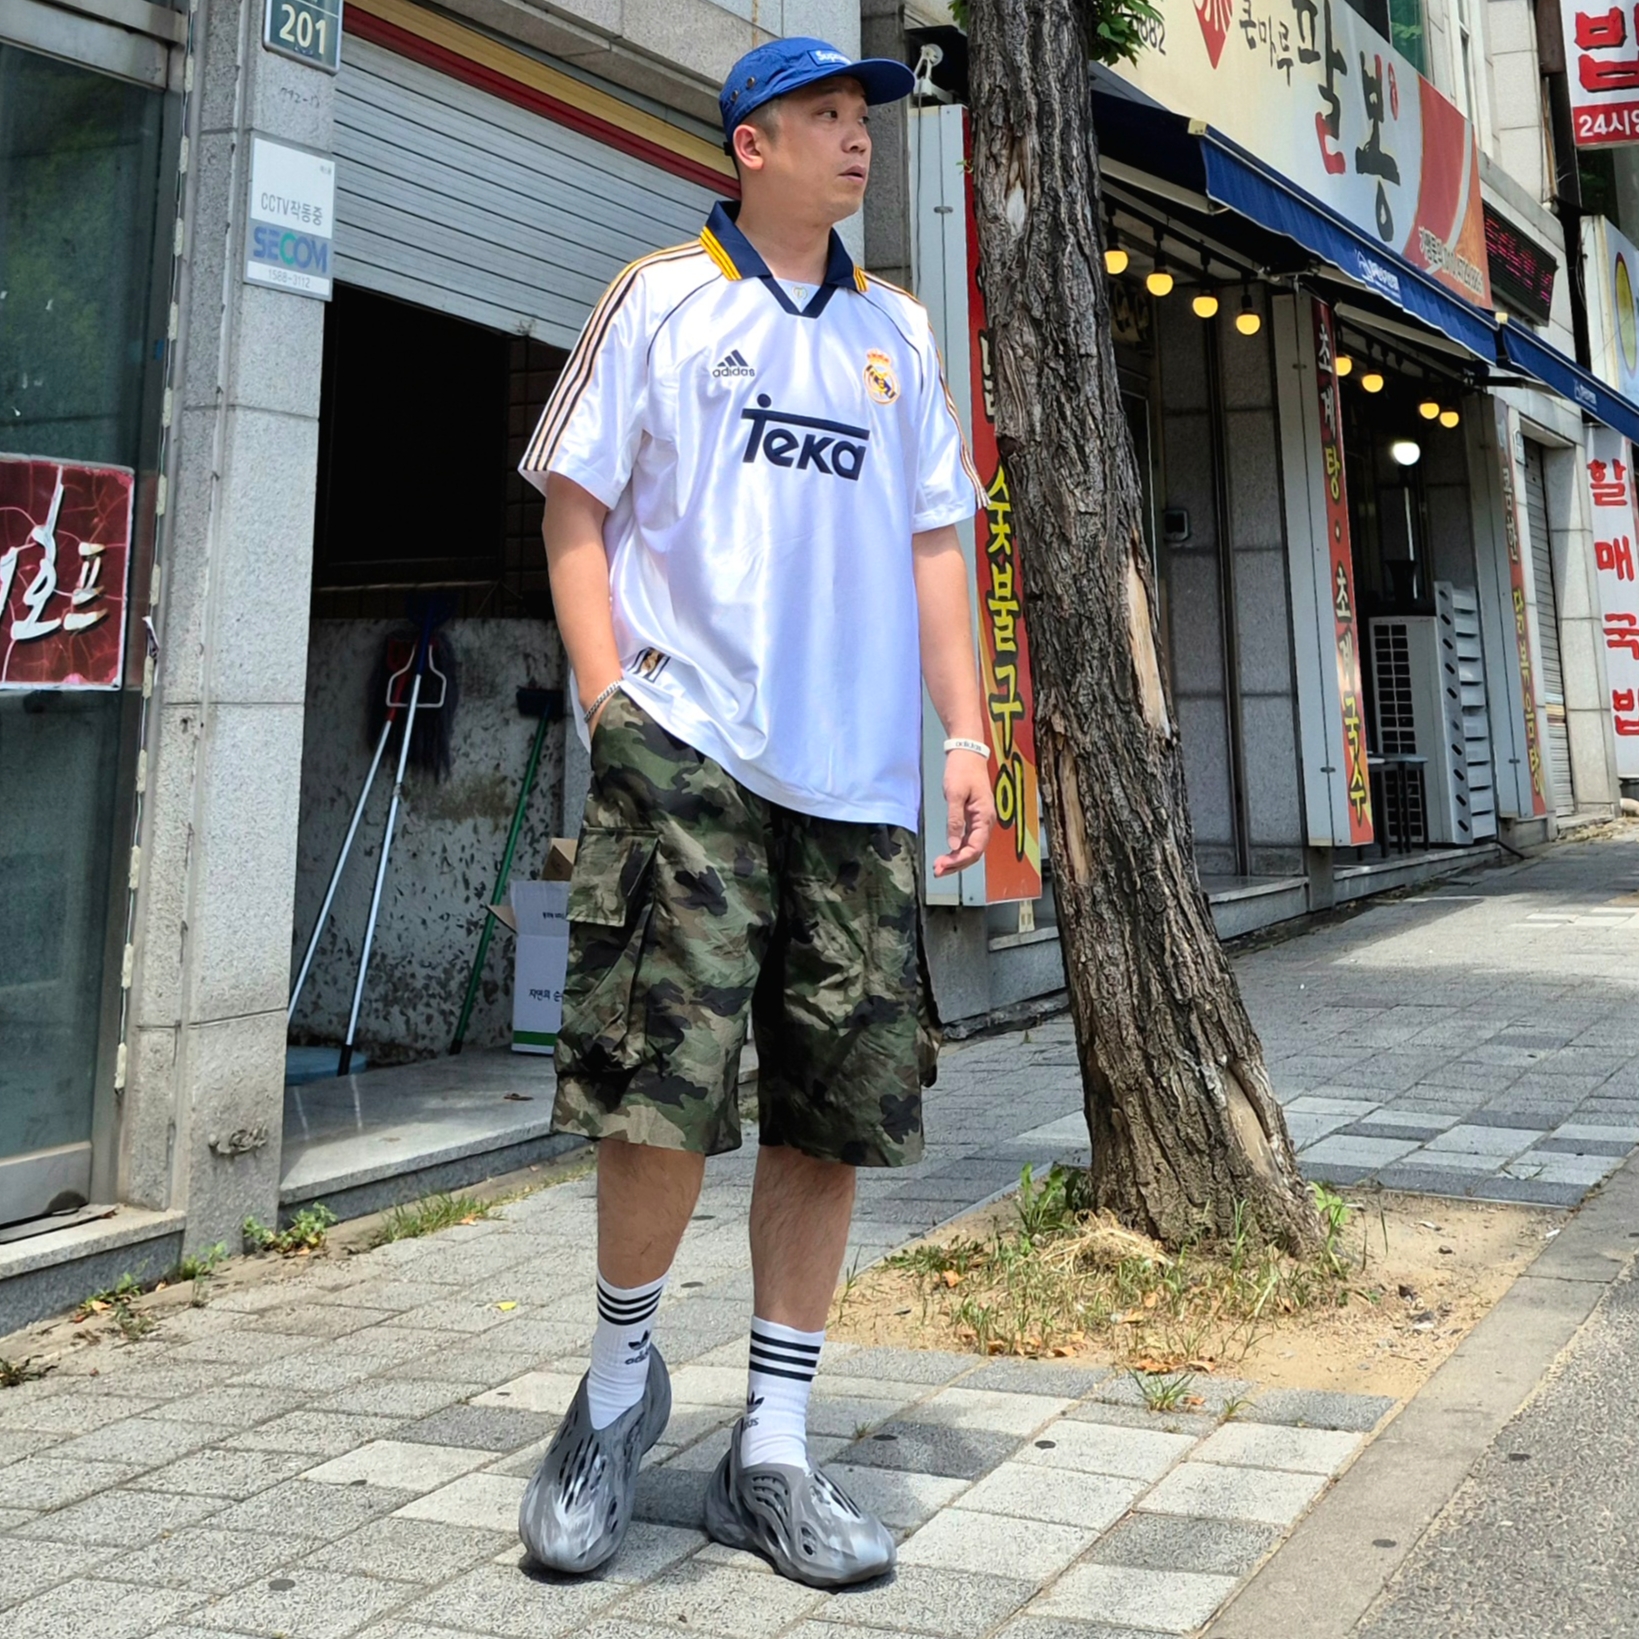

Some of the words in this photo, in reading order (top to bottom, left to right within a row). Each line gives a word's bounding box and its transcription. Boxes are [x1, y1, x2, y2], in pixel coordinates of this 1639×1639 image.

[279, 3, 326, 55] 201
[261, 192, 324, 227] CCTV작동중
[253, 225, 329, 274] SECOM
[267, 268, 312, 290] 1588-3112
[711, 366, 756, 379] adidas
[1318, 322, 1342, 502] 초계탕
[1335, 559, 1368, 829] 초계국수
[986, 462, 1026, 858] 숯불구이
